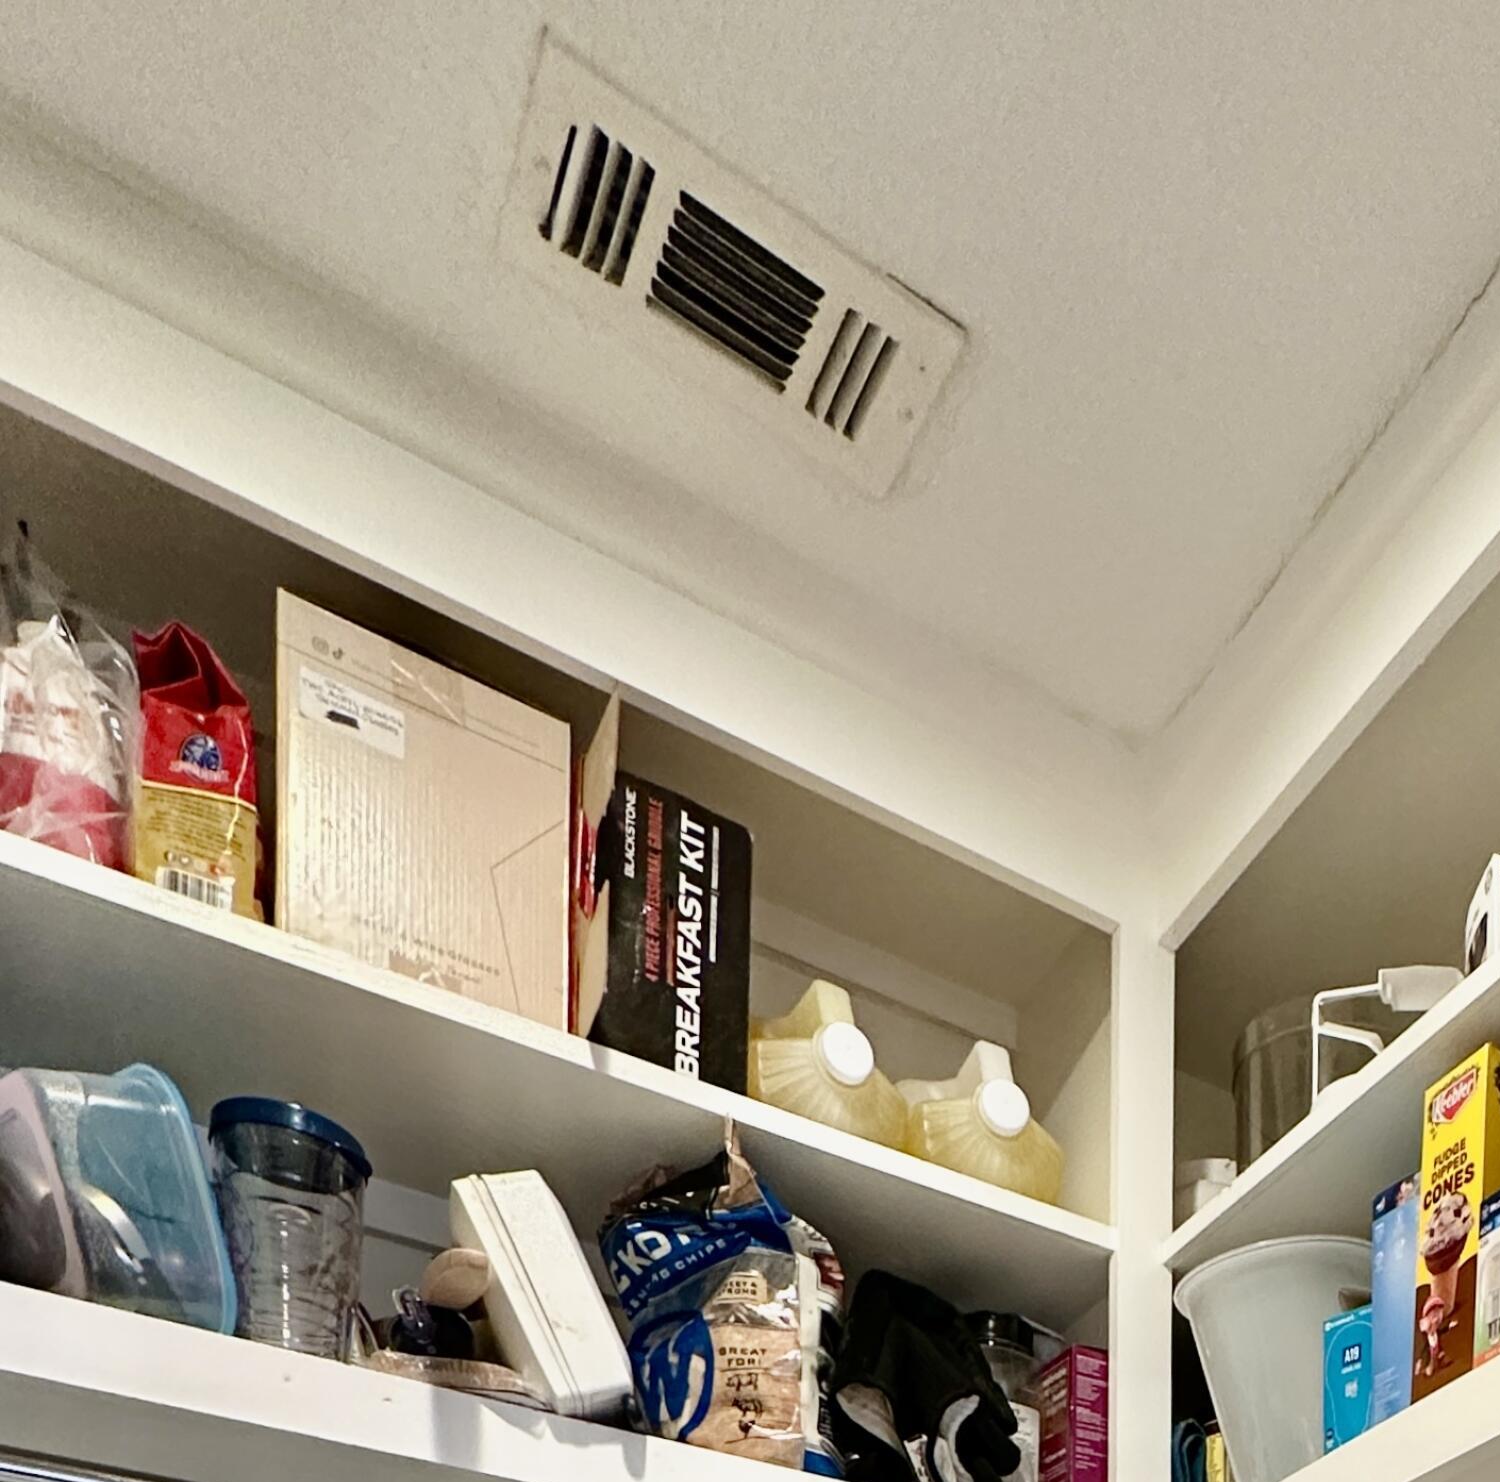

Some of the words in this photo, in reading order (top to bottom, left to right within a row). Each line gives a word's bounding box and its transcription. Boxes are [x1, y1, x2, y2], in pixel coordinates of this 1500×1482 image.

[624, 785, 637, 880] BLACKSTONE
[679, 809, 706, 874] KIT
[674, 872, 704, 1081] BREAKFAST
[1433, 1078, 1475, 1120] Keebler
[1431, 1152, 1468, 1185] DIPPED
[1433, 1137, 1467, 1169] FUDGE
[1423, 1163, 1475, 1210] CONES
[717, 1346, 767, 1357] GREAT
[1343, 1345, 1360, 1364] A19
